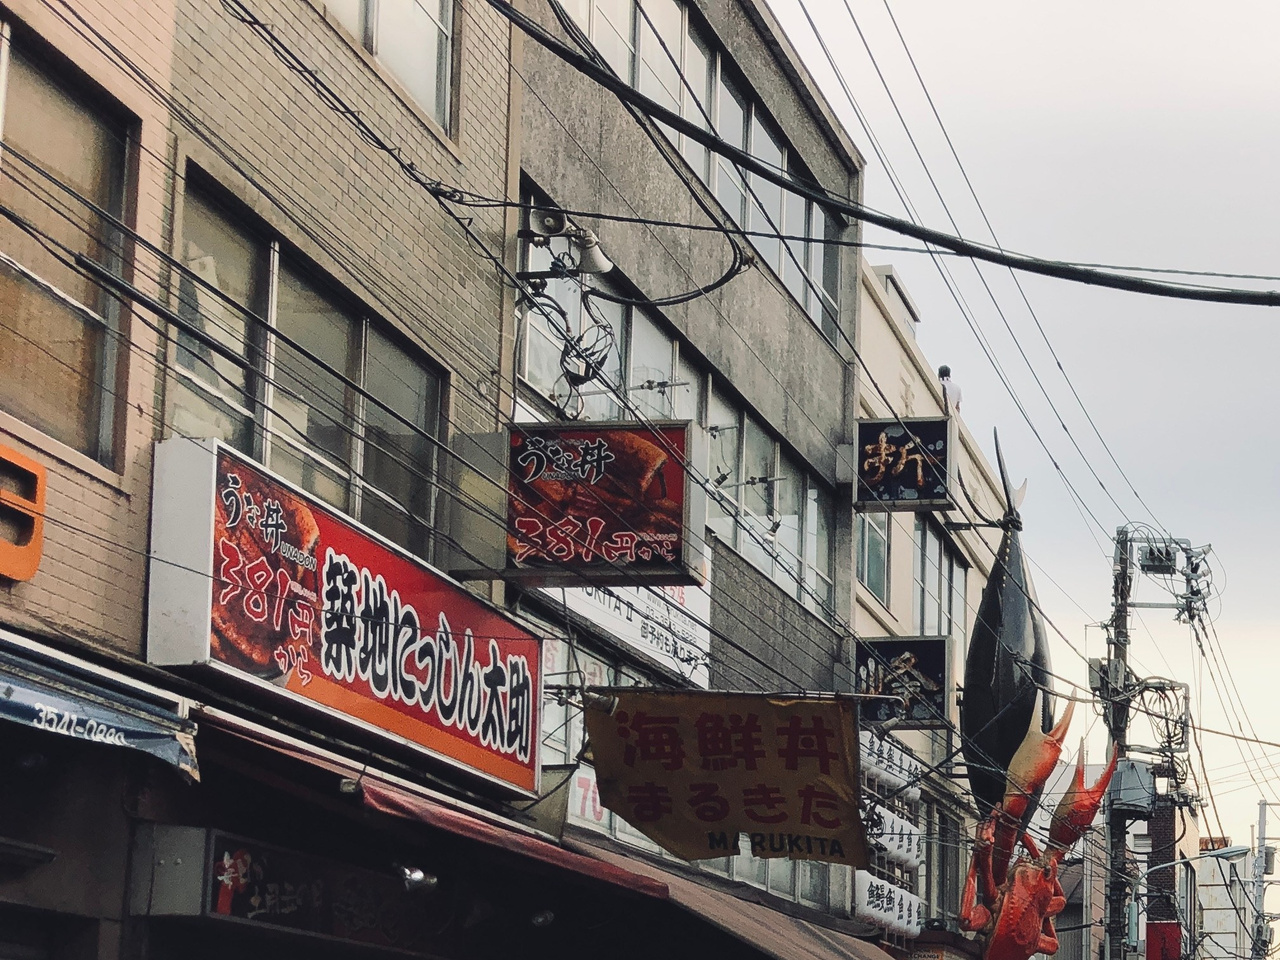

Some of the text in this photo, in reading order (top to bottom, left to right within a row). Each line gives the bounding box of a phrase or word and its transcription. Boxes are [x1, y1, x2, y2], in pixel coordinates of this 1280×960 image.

[281, 541, 317, 572] UNADON
[616, 711, 839, 774] 海鮮丼
[628, 782, 841, 829] まるきた
